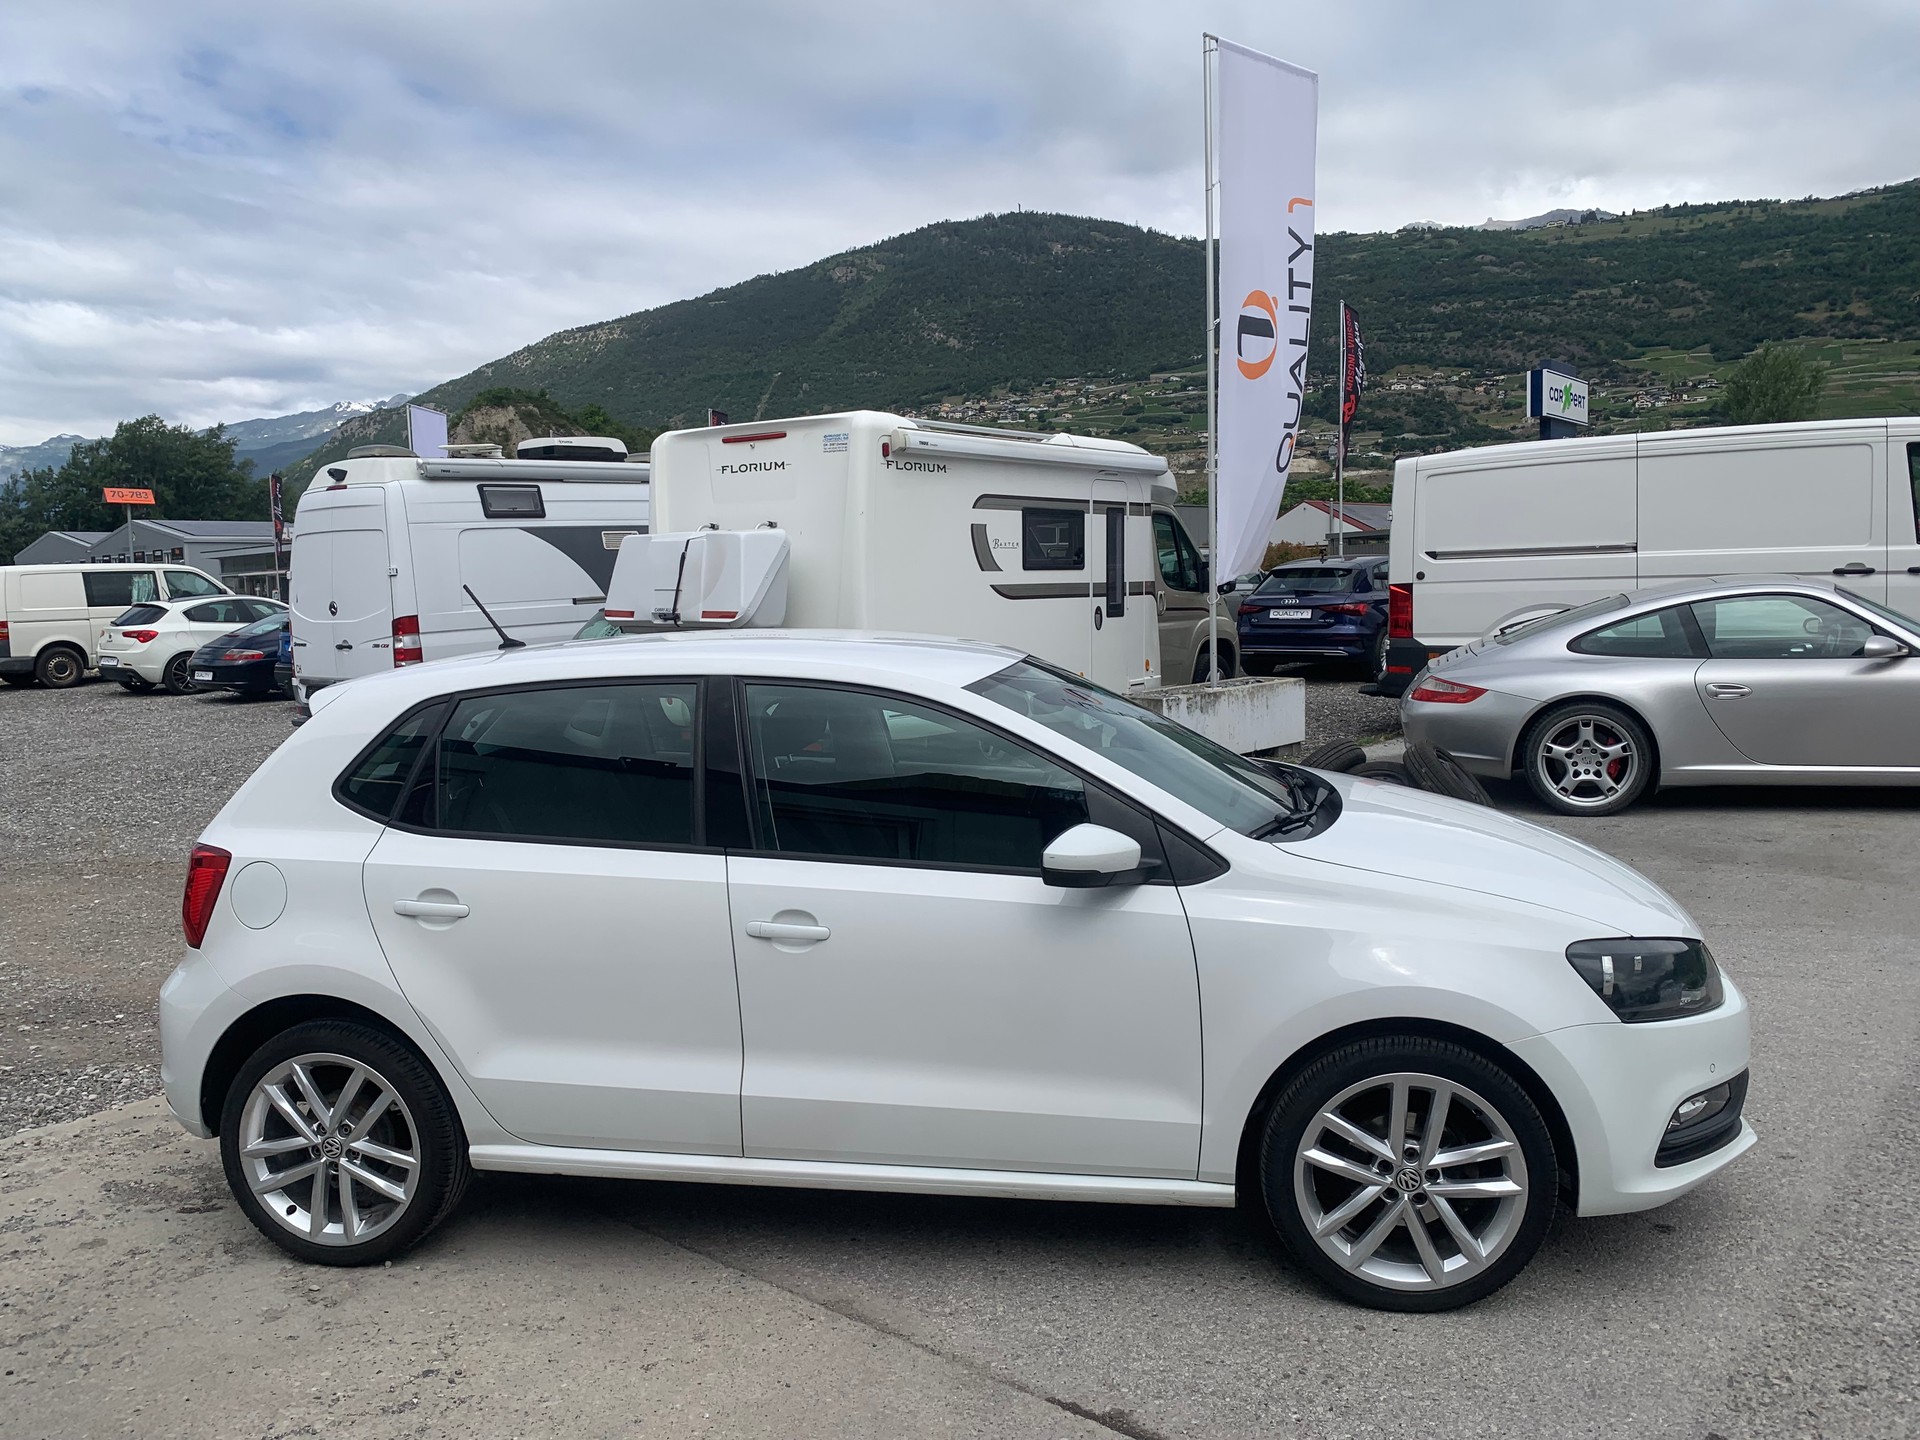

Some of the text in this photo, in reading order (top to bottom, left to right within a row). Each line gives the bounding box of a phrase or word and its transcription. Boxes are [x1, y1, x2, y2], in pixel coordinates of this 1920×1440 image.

[1275, 226, 1313, 474] QUALITY
[721, 461, 786, 475] FLORIUM
[886, 460, 947, 474] FLORIUM
[109, 490, 149, 500] 70-783
